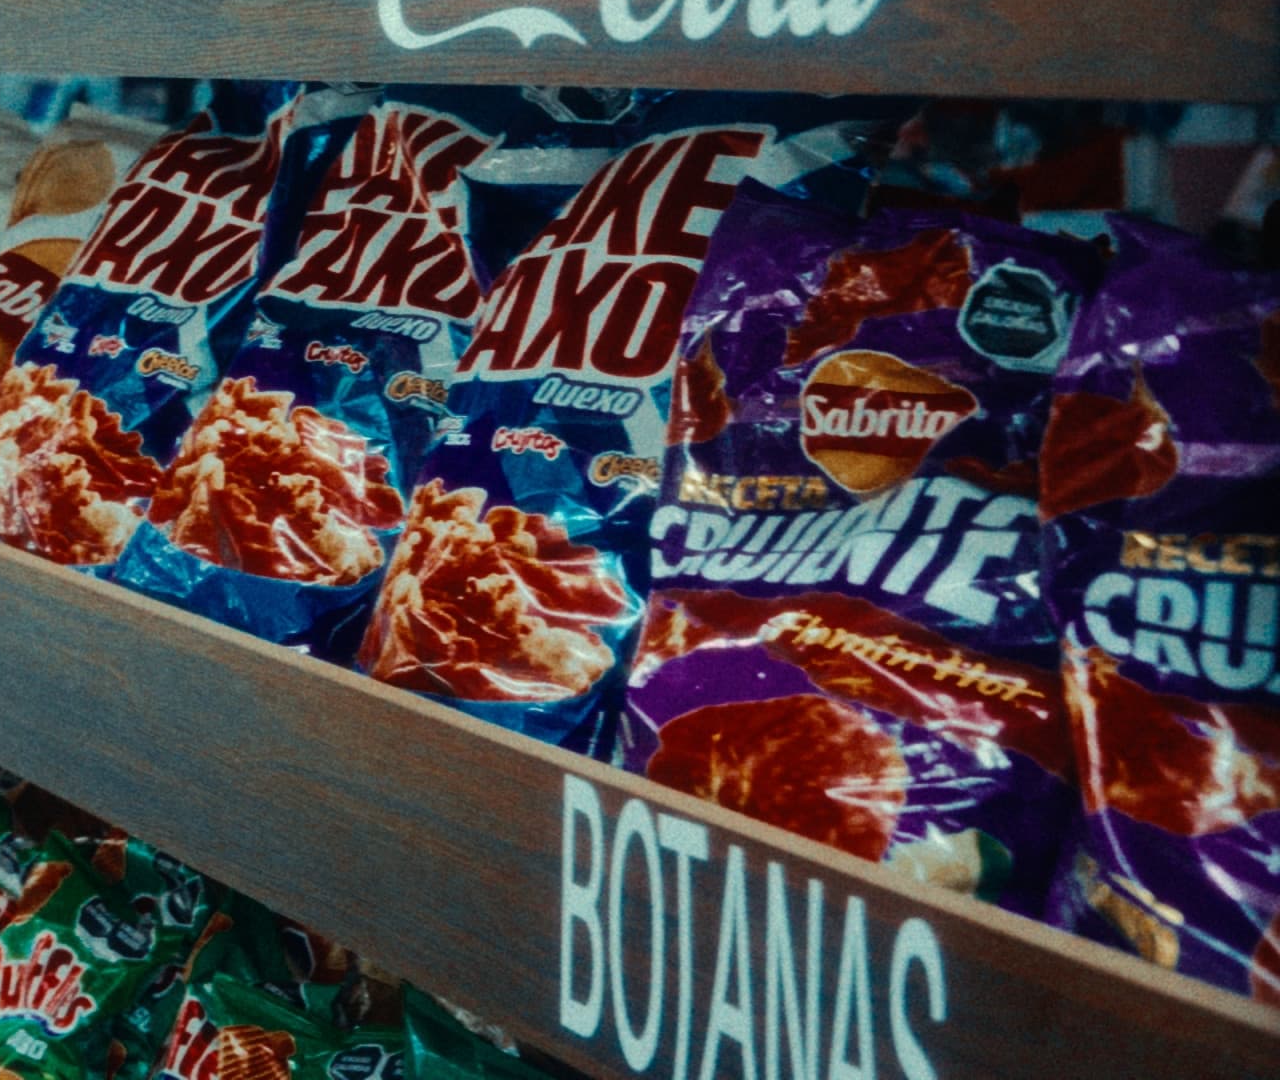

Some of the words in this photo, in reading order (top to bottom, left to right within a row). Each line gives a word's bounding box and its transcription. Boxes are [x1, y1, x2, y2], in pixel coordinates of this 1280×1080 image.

[533, 378, 643, 416] Quexo
[1083, 572, 1280, 696] CRU
[559, 773, 947, 1080] BOTANAS
